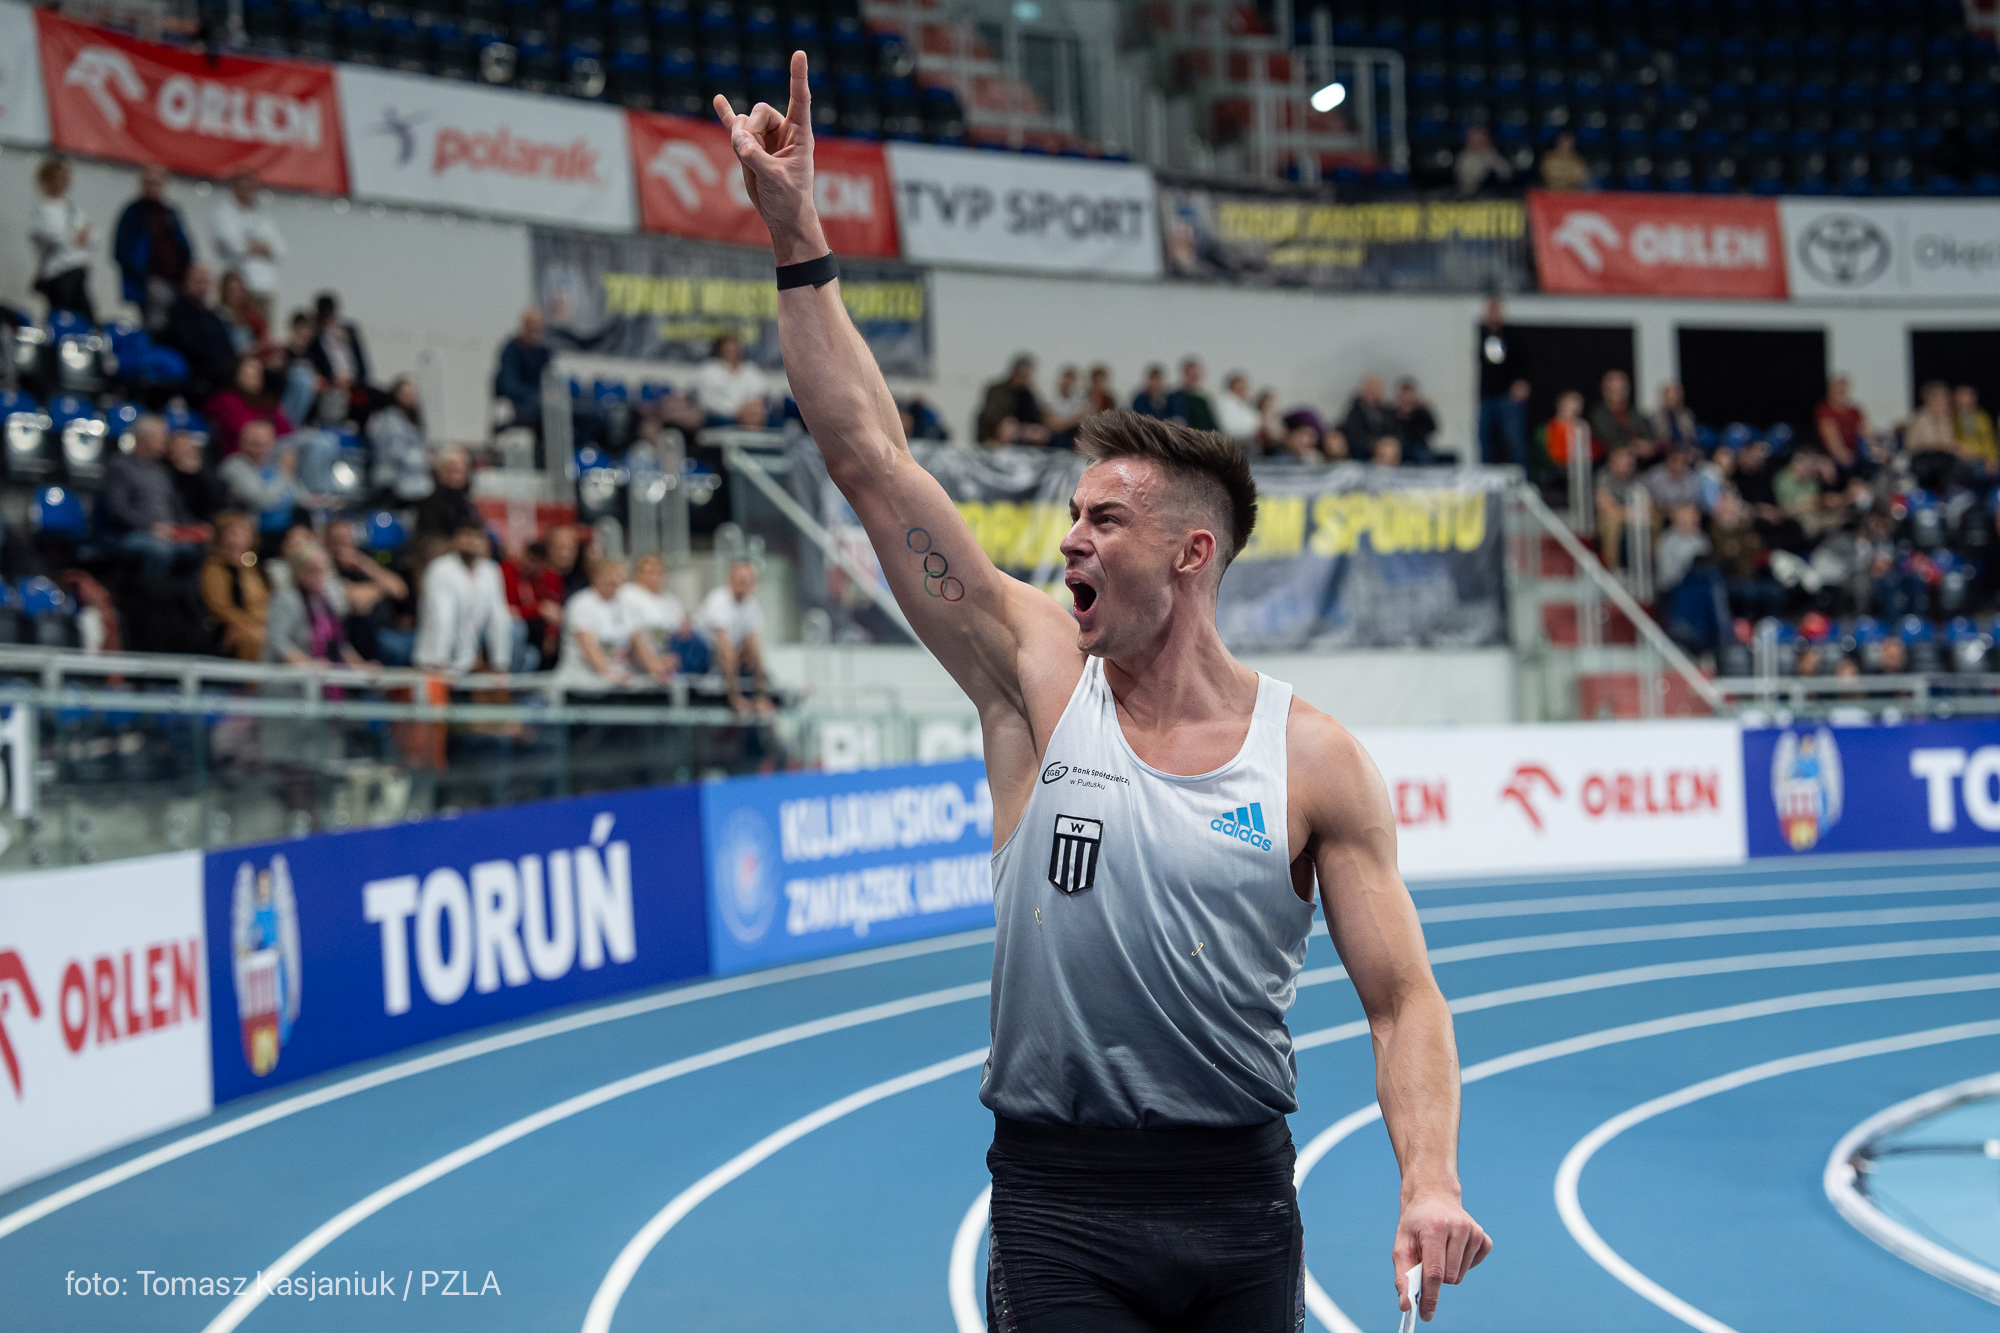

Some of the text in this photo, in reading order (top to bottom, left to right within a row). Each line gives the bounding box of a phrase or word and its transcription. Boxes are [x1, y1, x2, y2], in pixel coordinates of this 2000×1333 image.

[156, 71, 323, 149] ORLEN
[902, 180, 1143, 241] TVP SPORT
[1629, 223, 1771, 271] ORLEN
[1310, 487, 1486, 557] SPORTU
[1072, 766, 1091, 776] Bank
[1582, 768, 1720, 818] ORLEN
[1071, 822, 1085, 834] W
[1210, 818, 1273, 852] adidas
[363, 812, 637, 1016] TORUŃ
[58, 936, 200, 1056] ORLEN
